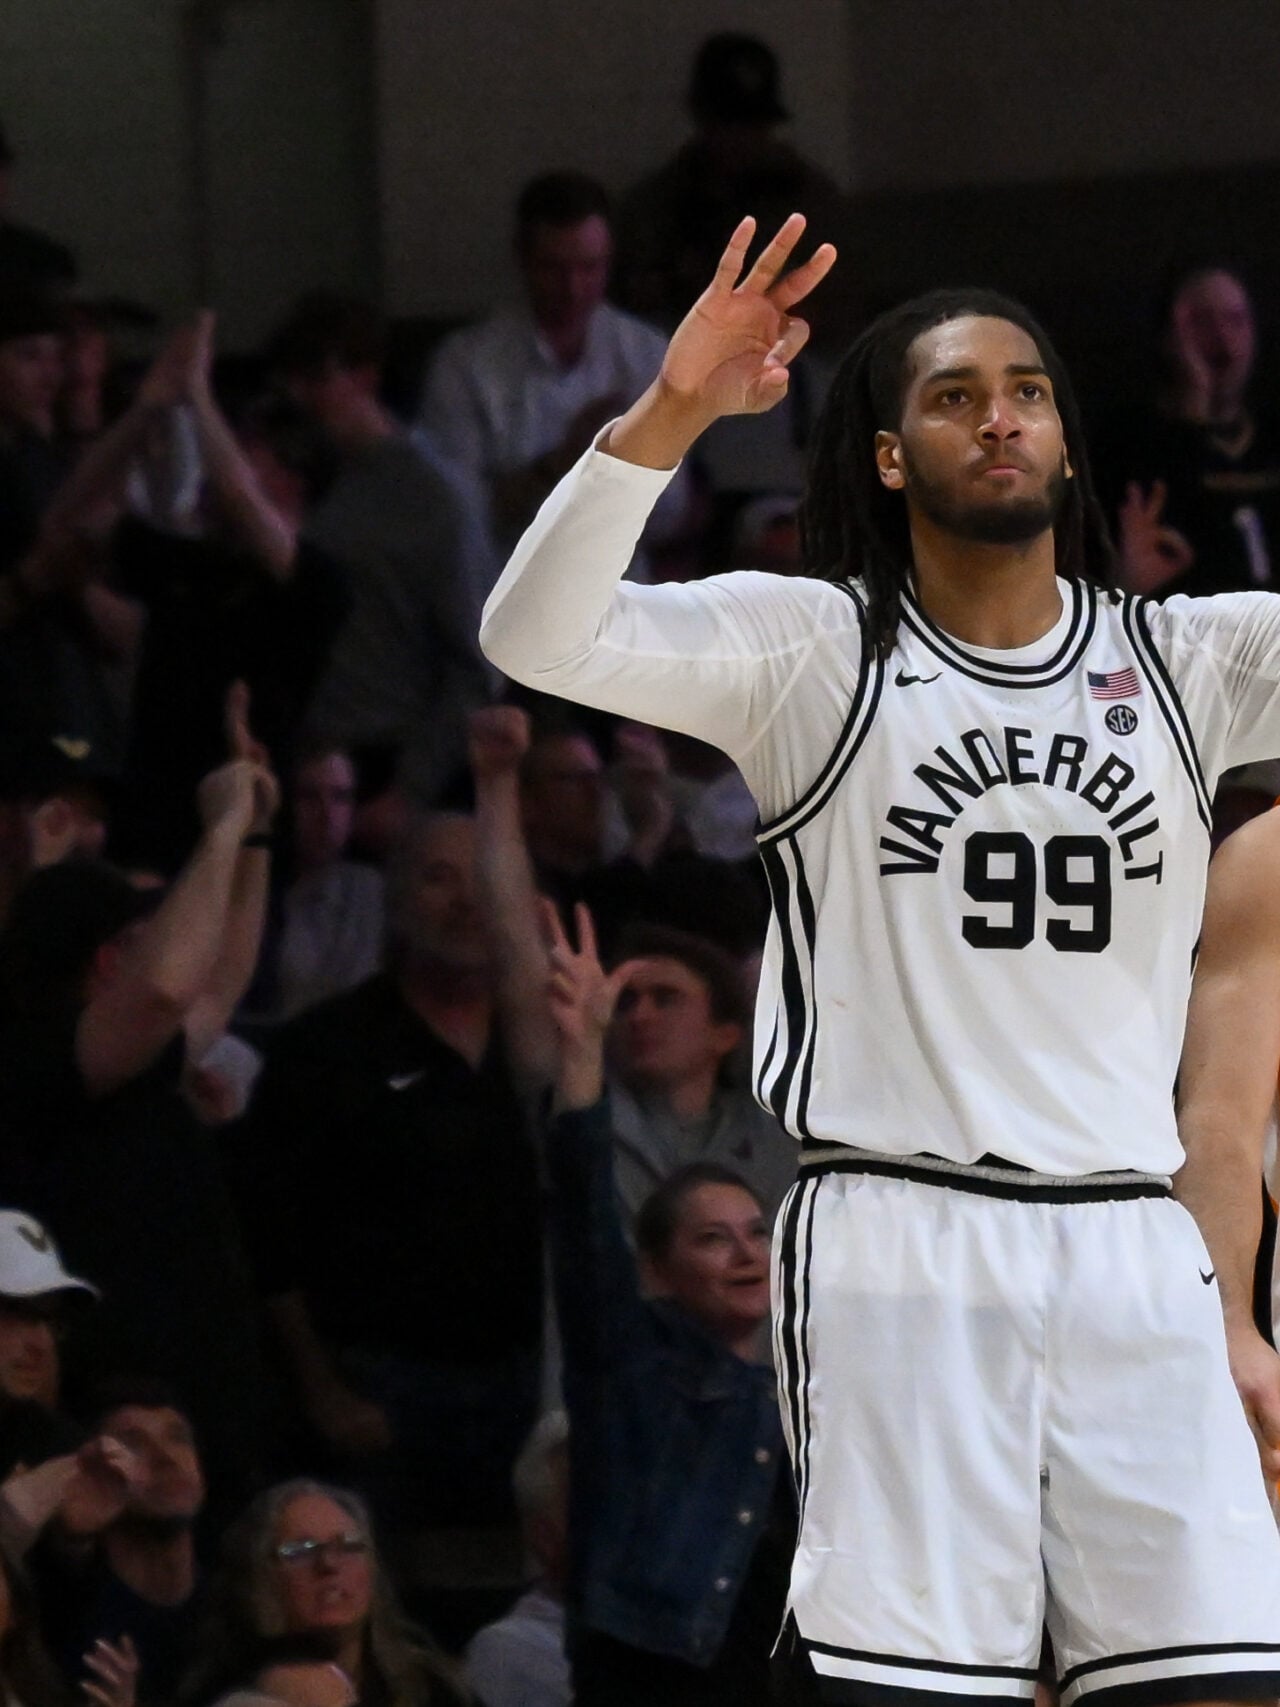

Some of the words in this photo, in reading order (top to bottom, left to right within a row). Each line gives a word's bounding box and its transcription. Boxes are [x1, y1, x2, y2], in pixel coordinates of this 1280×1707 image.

[1107, 706, 1136, 733] SEC
[879, 726, 1164, 886] VANDERBILT
[961, 831, 1112, 954] 99
